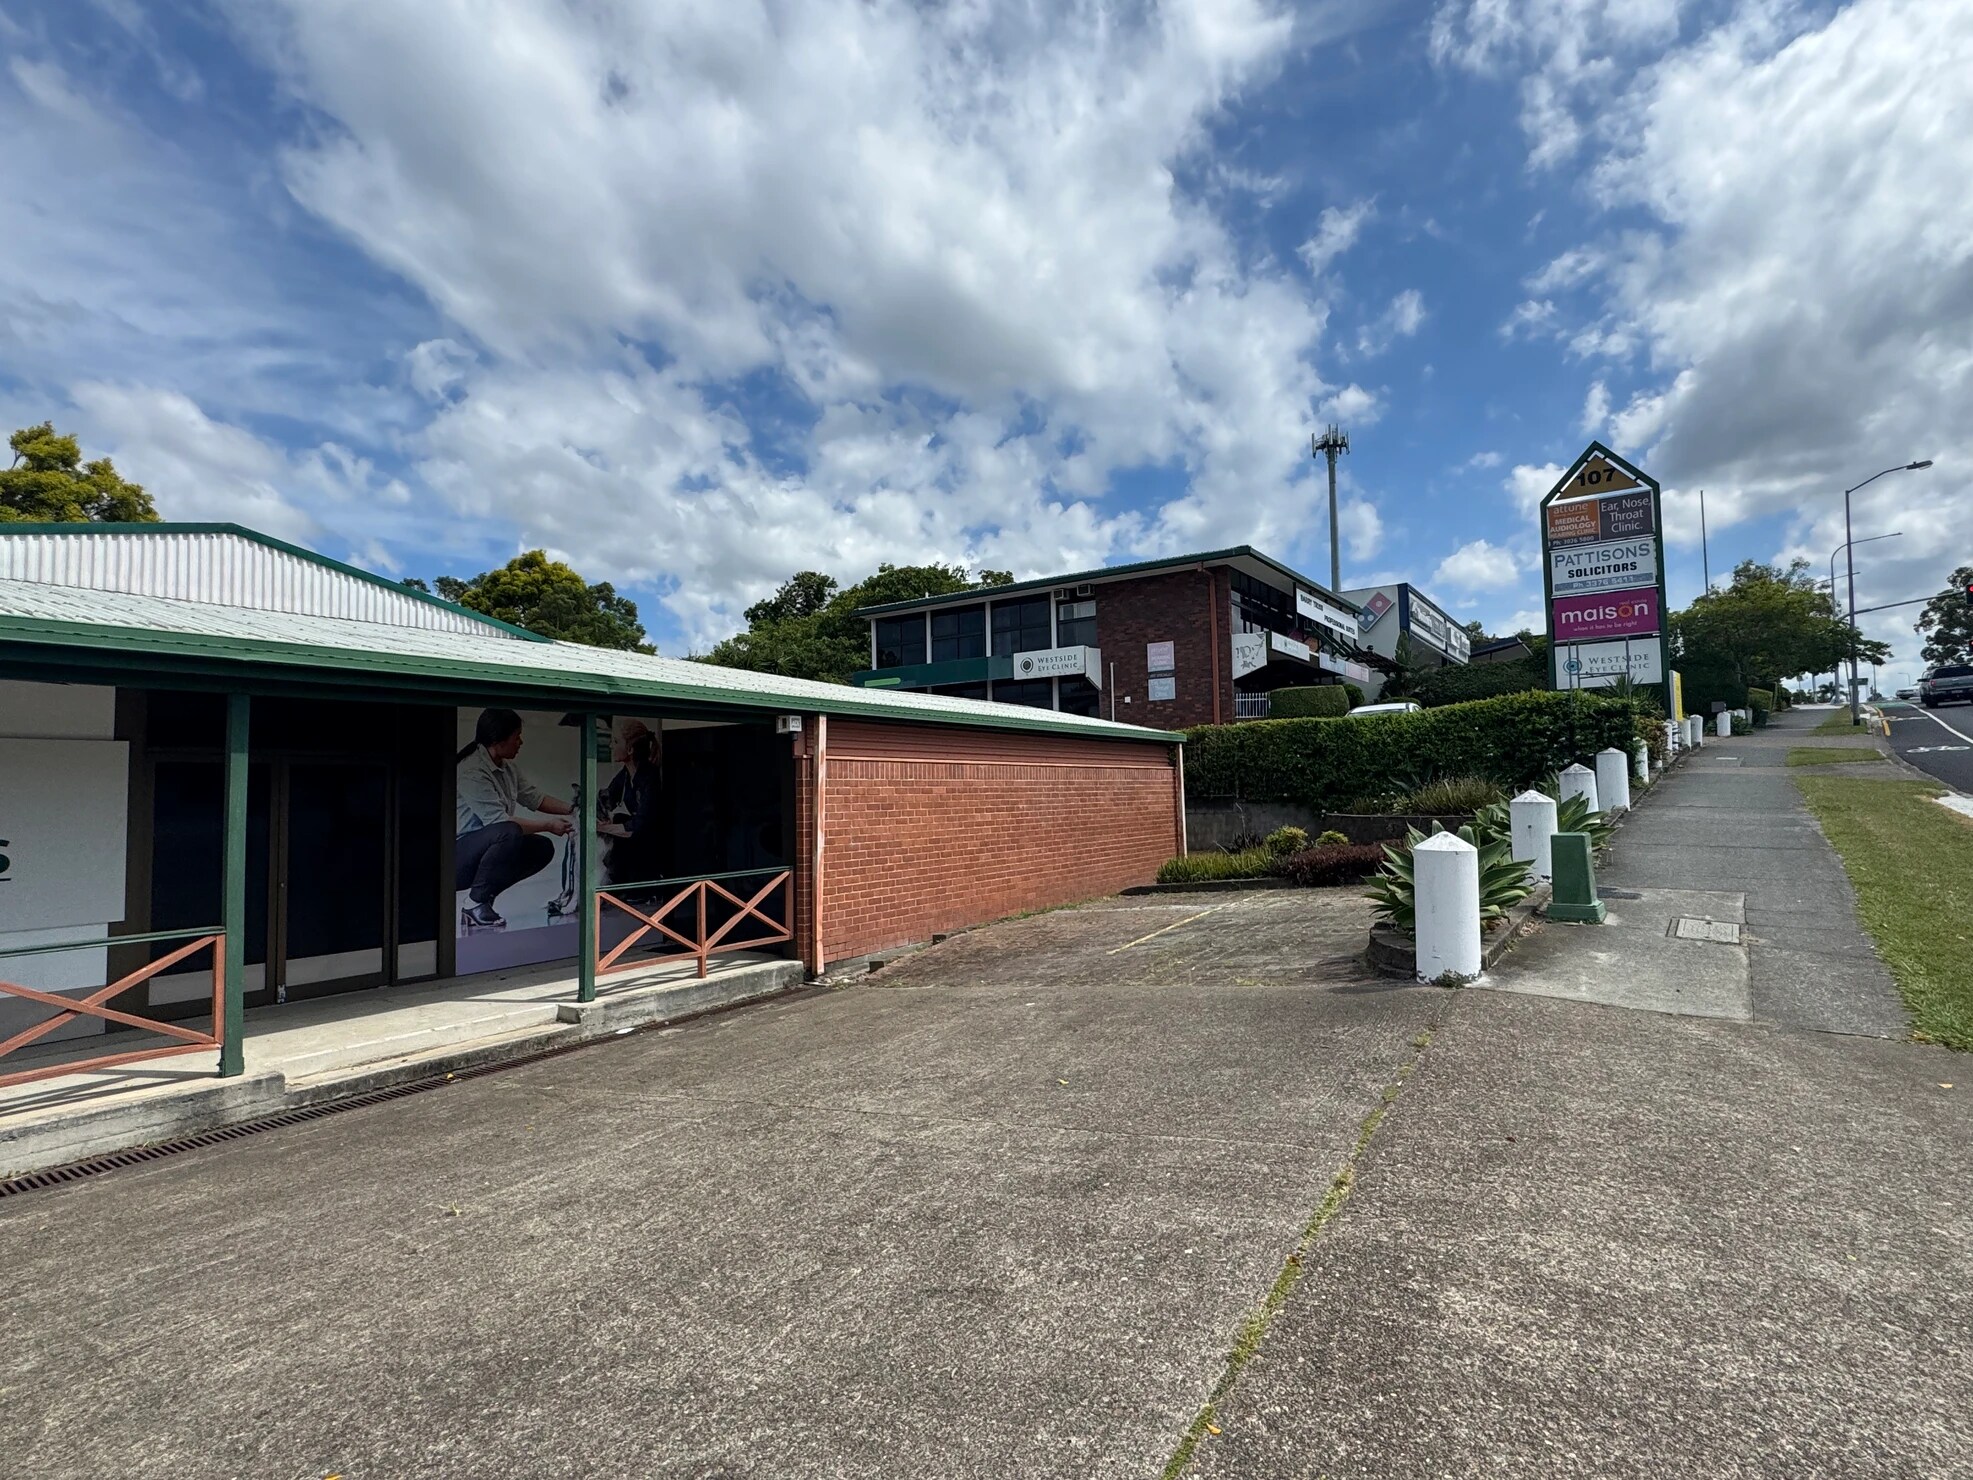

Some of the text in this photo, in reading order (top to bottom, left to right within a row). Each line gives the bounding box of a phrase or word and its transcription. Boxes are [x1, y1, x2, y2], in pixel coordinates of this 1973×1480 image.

[1577, 468, 1616, 487] 107
[1553, 503, 1589, 514] attune
[1601, 497, 1651, 512] Ear, Nose,
[1554, 515, 1590, 526] MEDICAL
[1609, 509, 1644, 521] Throat
[1550, 520, 1597, 533] AUDIOLOGY
[1611, 520, 1643, 533] Clinic.
[1554, 543, 1651, 568] PATTISONS
[1568, 561, 1638, 579] SOLICITORS
[1561, 603, 1649, 625] maison
[1623, 620, 1638, 628] right
[1037, 654, 1077, 664] WESTSIDE
[1051, 662, 1078, 670] CLINIC
